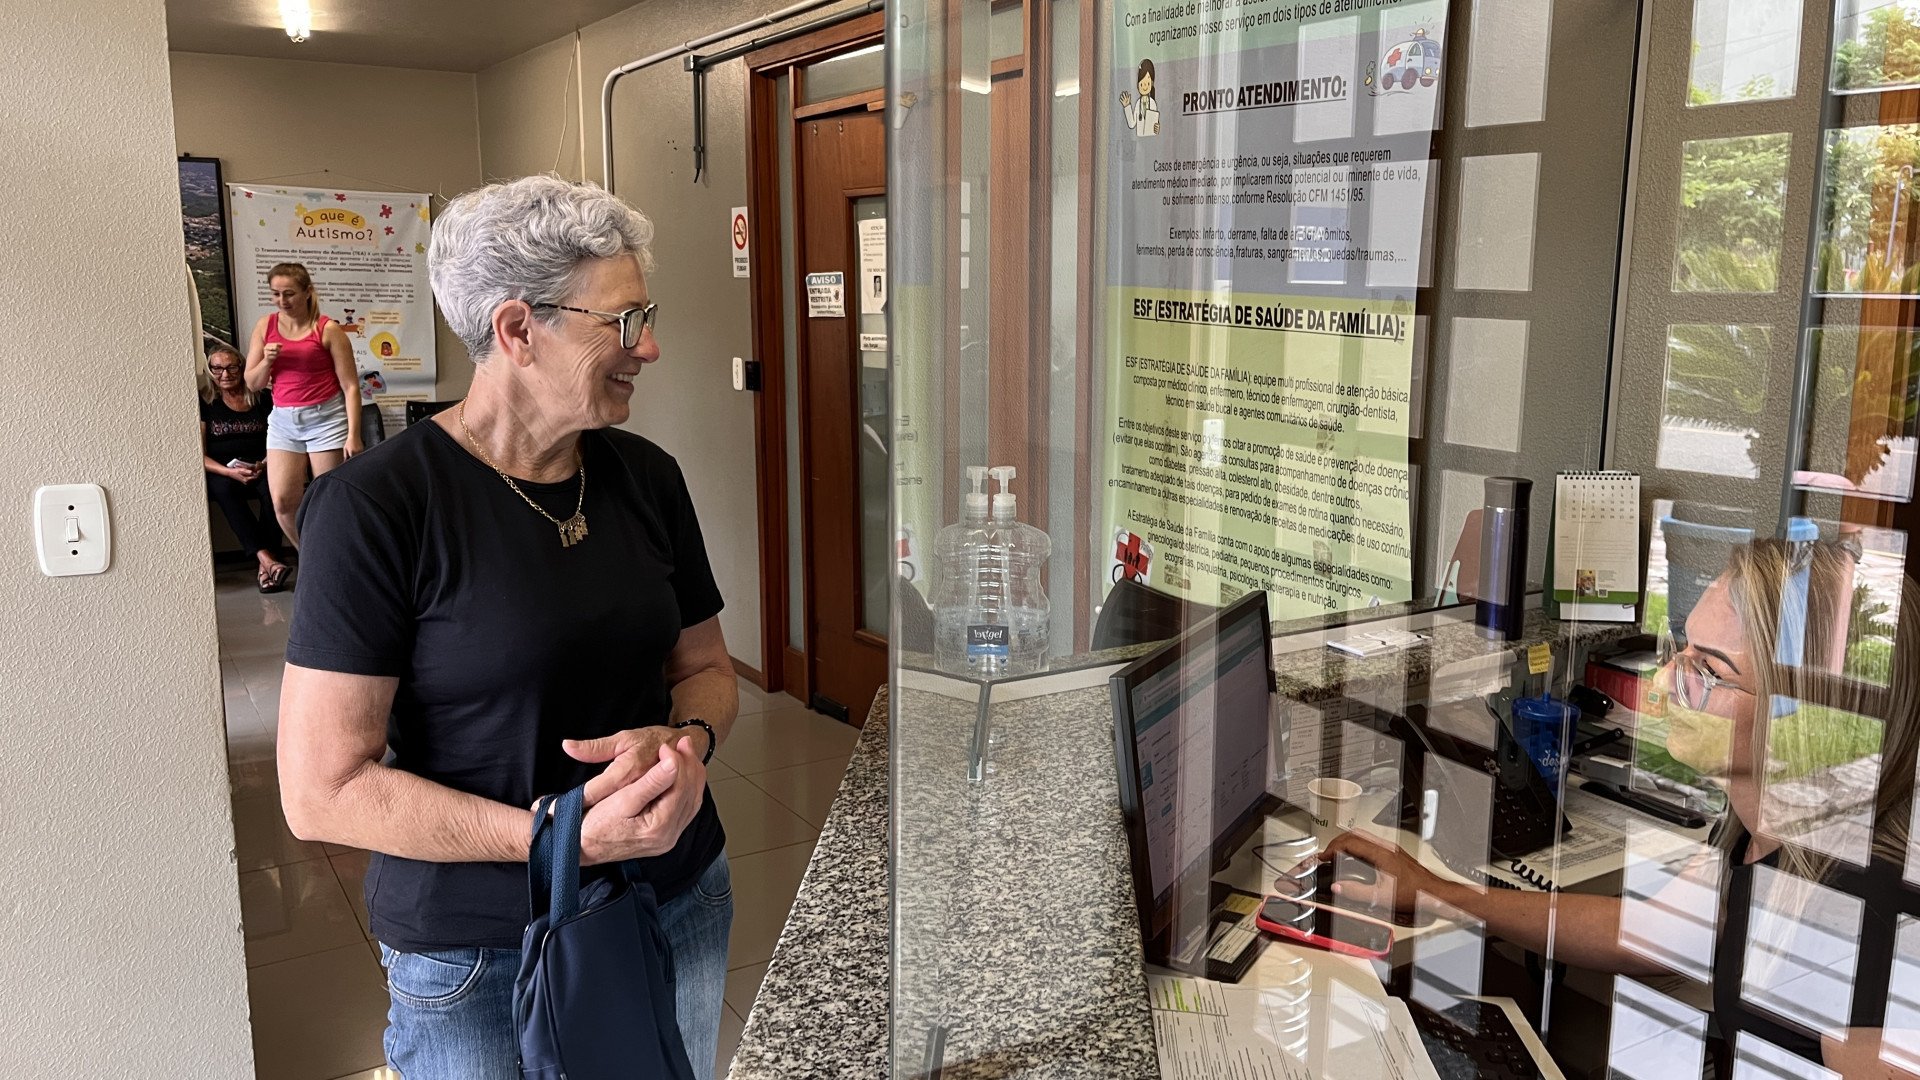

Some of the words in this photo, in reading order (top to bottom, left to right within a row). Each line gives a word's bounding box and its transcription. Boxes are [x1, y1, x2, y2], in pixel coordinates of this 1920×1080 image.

[1149, 25, 1197, 46] organizamos
[1199, 20, 1223, 35] nosso
[1226, 13, 1255, 32] serviço
[1258, 12, 1270, 25] em
[1273, 5, 1291, 22] dois
[1294, 4, 1317, 23] tipos
[1320, 1, 1331, 14] de
[1186, 1, 1195, 16] de
[1183, 88, 1234, 112] PRONTO
[1237, 75, 1346, 107] ATENDIMENTO:
[1261, 156, 1270, 167] ou
[1272, 153, 1291, 169] seja,
[1293, 151, 1331, 167] situações
[1333, 152, 1349, 166] que
[1351, 149, 1391, 165] requerem
[1233, 173, 1272, 188] implicarem
[1274, 171, 1293, 185] risco
[1294, 169, 1331, 187] potencial
[1333, 171, 1343, 182] ou
[1346, 168, 1380, 182] iminente
[1383, 166, 1394, 181] de
[1397, 165, 1421, 182] vida,
[1232, 191, 1265, 204] conforme
[1267, 189, 1306, 206] Resolução
[1309, 188, 1328, 202] CFM
[296, 227, 373, 241] Autismo?
[304, 216, 313, 226] O
[320, 211, 345, 223] que
[351, 215, 359, 226] é
[1186, 244, 1194, 256] de
[1227, 227, 1259, 242] derrame,
[1261, 227, 1277, 240] falta
[1278, 227, 1288, 240] de
[811, 276, 836, 284] AVISO
[1134, 298, 1152, 317] ESF
[1154, 298, 1231, 323] (ESTRATÉGIA
[1235, 305, 1252, 325] DE
[1255, 303, 1303, 329] SAÚDE
[1307, 309, 1326, 331] DA
[1329, 308, 1405, 342] FAMÍLIA):
[1254, 374, 1277, 388] equipe
[1295, 378, 1334, 394] profissional
[1335, 382, 1345, 395] de
[1346, 384, 1379, 401] atenção
[1239, 406, 1265, 421] agentes
[1266, 411, 1308, 427] comunitários
[1308, 416, 1318, 429] de
[1319, 418, 1344, 433] saúde.
[1247, 389, 1270, 404] técnico
[1272, 393, 1280, 404] de
[1281, 394, 1325, 413] enfermagem,
[1327, 401, 1398, 423] cirurgião-dentista,
[1253, 444, 1285, 461] promoção
[1286, 448, 1294, 460] de
[1295, 449, 1316, 465] saúde
[1324, 456, 1363, 475] prevenção
[1365, 460, 1375, 474] de
[1229, 456, 1258, 471] consultas
[1260, 461, 1274, 475] para
[1275, 465, 1336, 486] acompanhamento
[1337, 476, 1346, 489] de
[1349, 479, 1382, 497] doenças
[1229, 472, 1260, 487] colesterol
[1275, 481, 1310, 499] obesidade,
[1312, 489, 1335, 504] dentre
[1336, 495, 1363, 512] outros,
[1225, 487, 1240, 502] para
[1241, 489, 1262, 505] pedido
[1263, 495, 1270, 507] de
[1271, 498, 1297, 513] exames
[1298, 503, 1307, 516] de
[1308, 507, 1328, 521] rotina
[1329, 510, 1361, 527] quando
[1362, 518, 1405, 539] necessário,
[1230, 507, 1262, 523] renovação
[1263, 512, 1270, 524] de
[1271, 513, 1297, 532] receitas
[1298, 520, 1307, 533] de
[1308, 525, 1355, 544] medicações
[1356, 533, 1365, 546] de
[1366, 538, 1380, 551] uso
[1217, 535, 1234, 547] conta
[1235, 540, 1248, 551] com
[1254, 545, 1270, 558] apoio
[1271, 548, 1280, 561] de
[1281, 551, 1312, 569] algumas
[1313, 561, 1369, 583] especialidades
[1371, 575, 1393, 591] como:
[1240, 557, 1269, 575] pequenos
[1271, 567, 1325, 589] procedimentos
[1325, 578, 1363, 600] cirúrgicos,
[1261, 578, 1300, 598] fisioterapia
[1308, 591, 1338, 611] nutrição.
